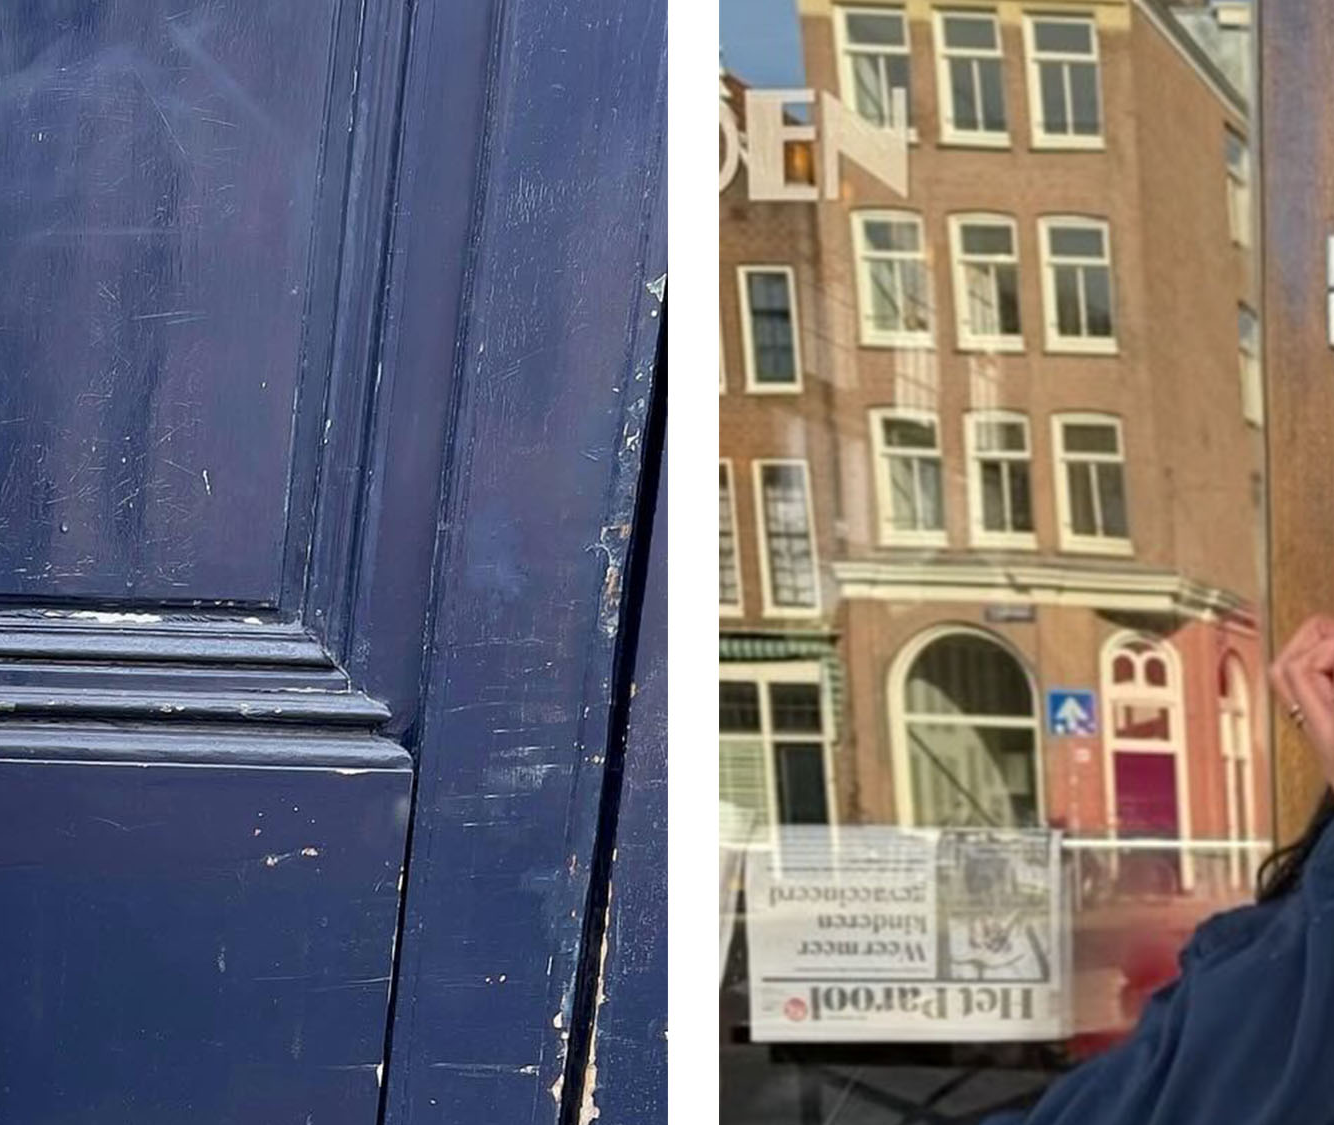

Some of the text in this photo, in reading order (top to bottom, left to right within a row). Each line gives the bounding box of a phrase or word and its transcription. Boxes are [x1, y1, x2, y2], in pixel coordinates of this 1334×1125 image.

[818, 913, 928, 935] kinderen
[796, 940, 926, 962] Weer meer
[811, 986, 949, 1021] Parool
[958, 986, 1034, 1020] Het
